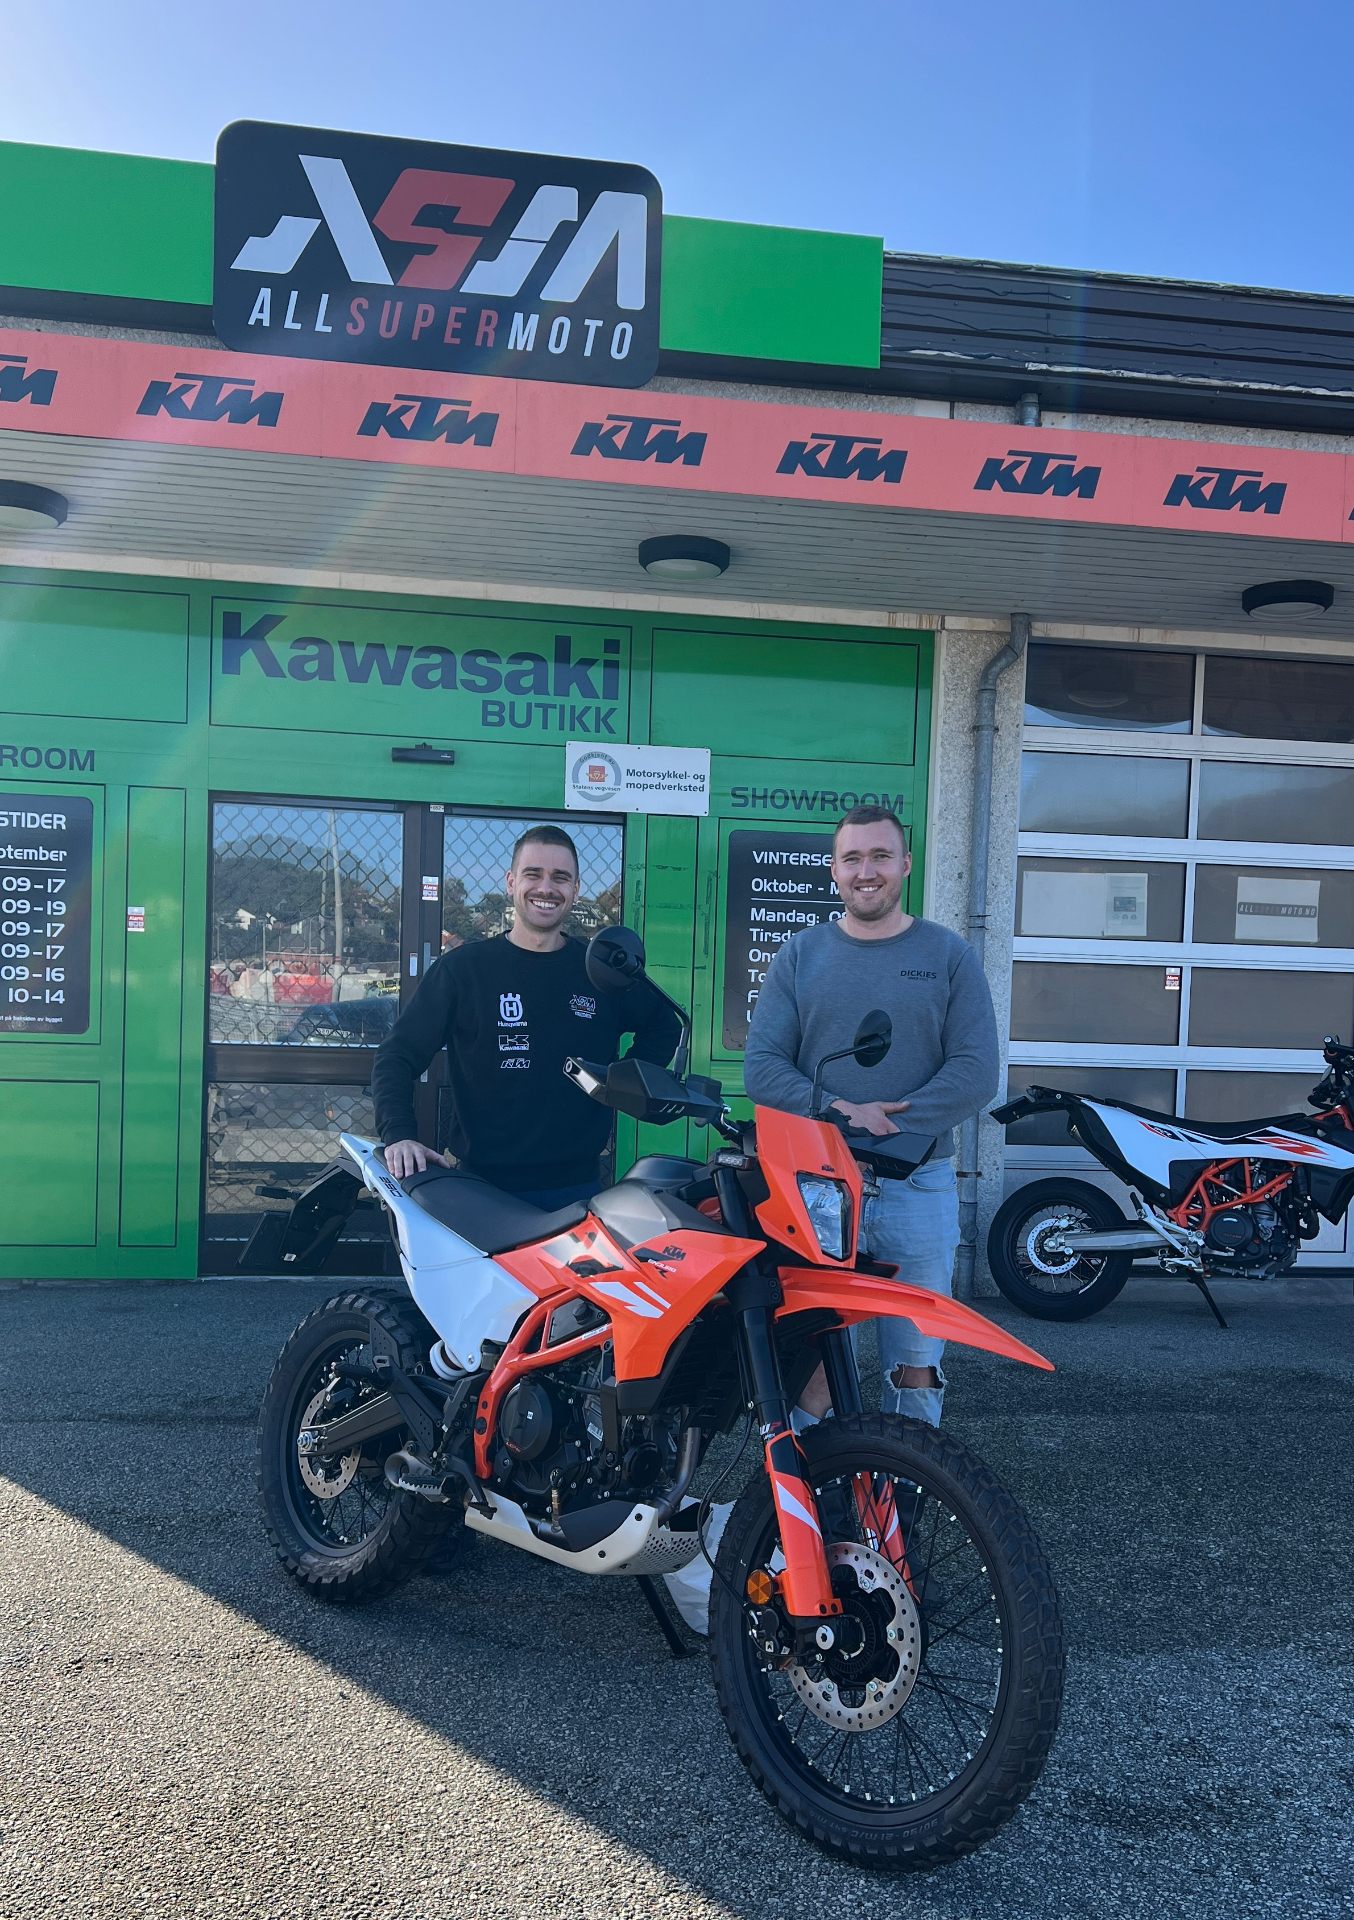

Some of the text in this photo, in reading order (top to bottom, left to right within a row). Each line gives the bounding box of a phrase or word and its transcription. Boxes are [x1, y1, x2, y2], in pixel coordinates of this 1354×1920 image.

[136, 372, 285, 428] KTM
[356, 393, 500, 447] KTM
[570, 413, 708, 467] KTM
[775, 432, 908, 484] KTM
[973, 449, 1102, 499] KTM
[1162, 466, 1288, 515] KTM
[221, 611, 620, 701] Kawasaki
[481, 700, 618, 735] BUTIKK
[626, 768, 706, 783] Motorsykkel- og
[626, 781, 705, 793] mopedverksted
[751, 877, 812, 894] Oktober
[750, 907, 820, 926] Mandag:
[749, 928, 797, 943] Tirsd
[900, 970, 937, 980] DICKIES
[662, 1245, 687, 1262] KTM
